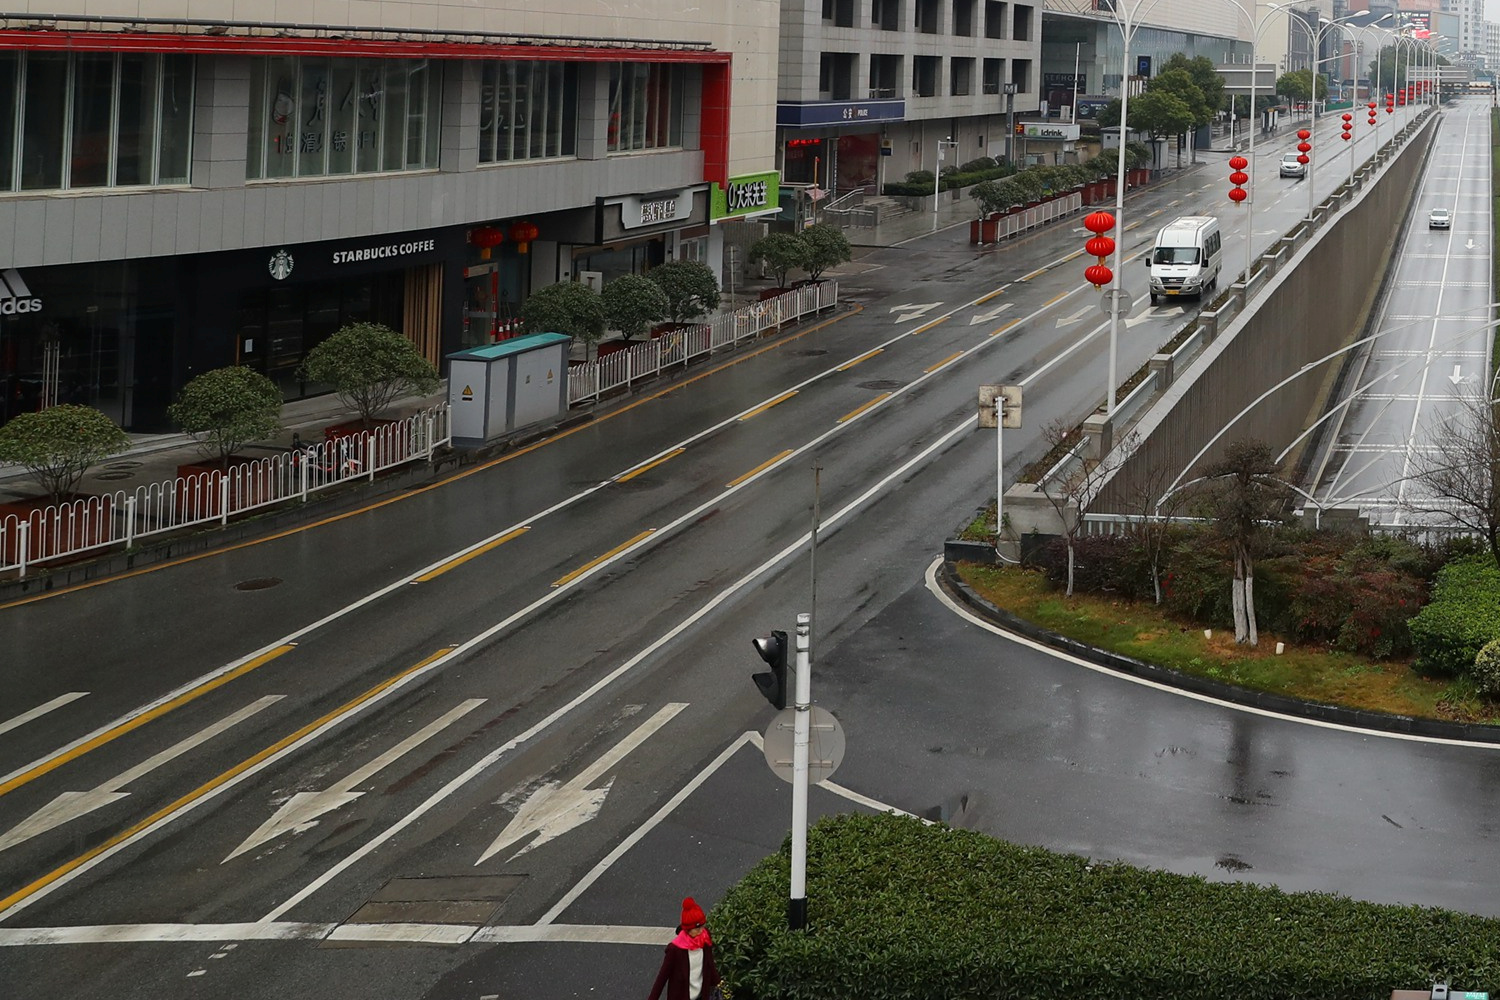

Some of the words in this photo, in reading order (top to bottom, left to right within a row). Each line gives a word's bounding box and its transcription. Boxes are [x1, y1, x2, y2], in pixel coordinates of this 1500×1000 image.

[842, 108, 853, 119] 公安
[736, 181, 768, 210] 大米先生
[332, 244, 398, 264] STARBUCKS
[399, 239, 435, 255] COFFEE
